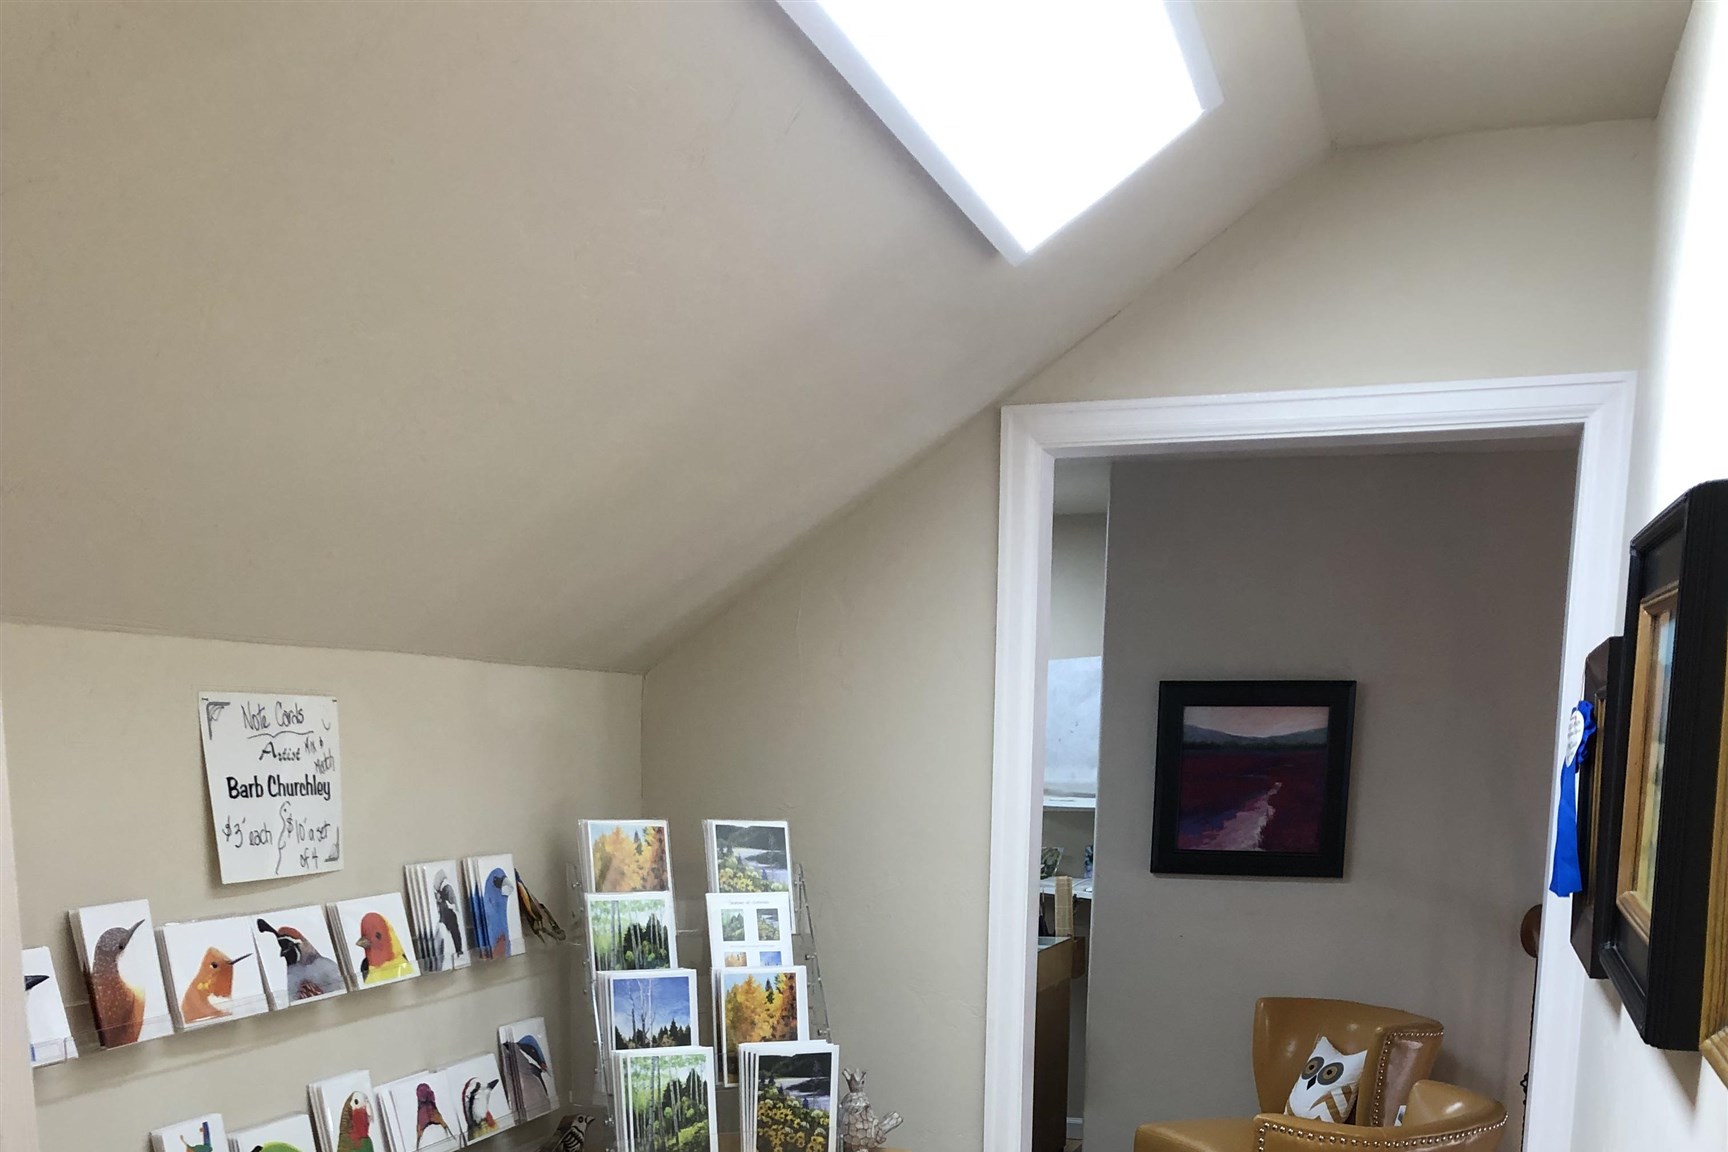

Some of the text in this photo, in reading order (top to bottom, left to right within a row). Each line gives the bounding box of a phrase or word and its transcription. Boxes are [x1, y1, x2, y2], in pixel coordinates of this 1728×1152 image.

[241, 701, 304, 731] Note Cards
[259, 741, 301, 762] Artist
[226, 774, 331, 801] Barb Churchley
[249, 822, 273, 847] each
[308, 828, 316, 841] a
[316, 820, 331, 843] set
[300, 847, 319, 869] of 4
